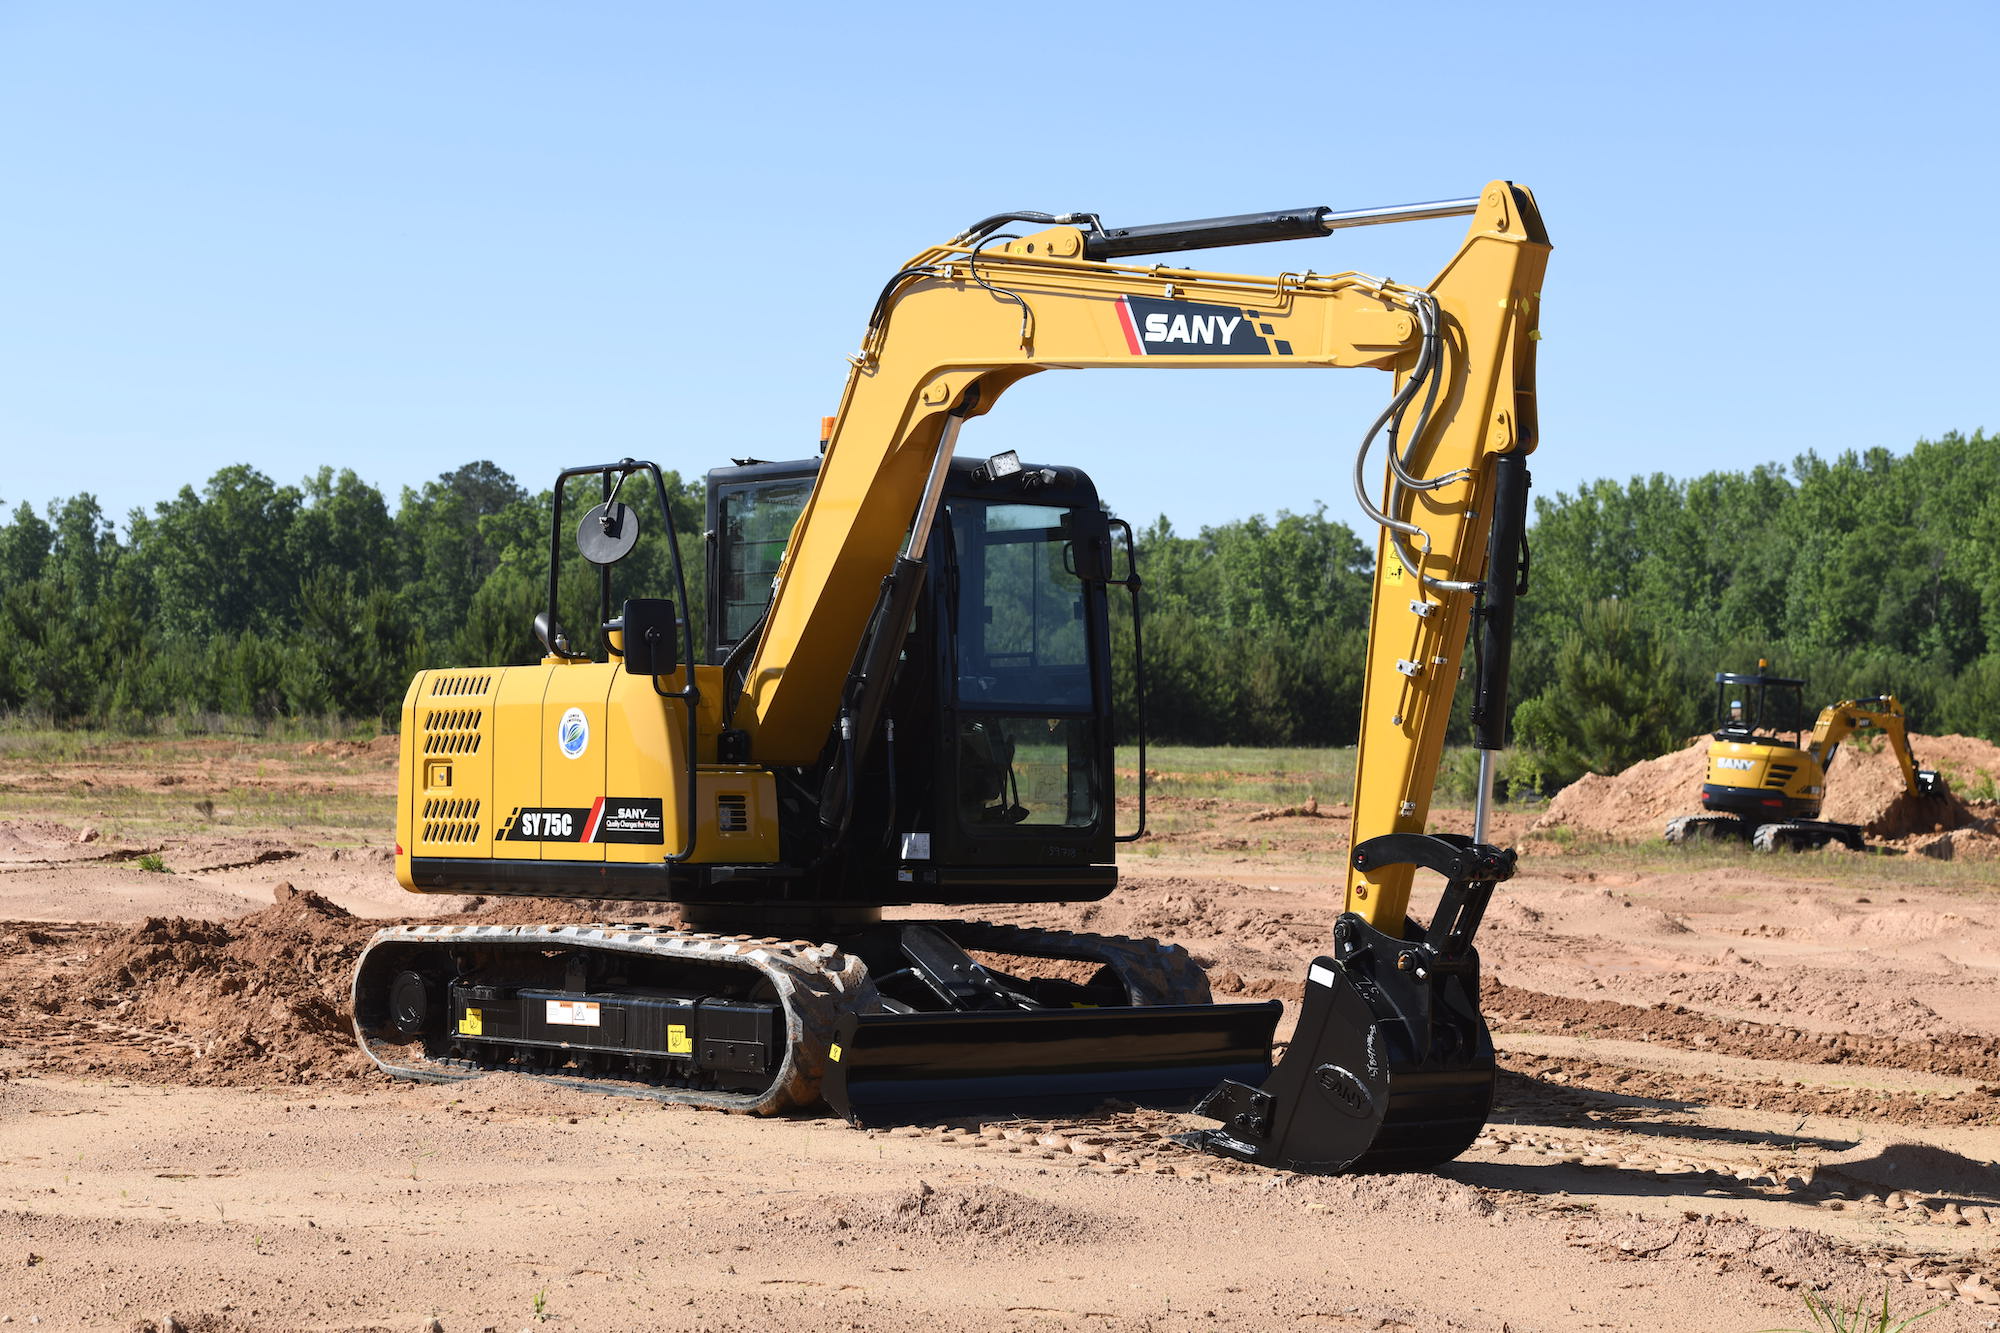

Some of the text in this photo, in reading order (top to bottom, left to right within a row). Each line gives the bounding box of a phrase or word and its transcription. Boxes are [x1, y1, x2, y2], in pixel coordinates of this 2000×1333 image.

[1144, 313, 1242, 345] SANY
[1717, 757, 1756, 771] SANY
[617, 808, 648, 819] SANY
[606, 819, 620, 828] Quality
[620, 820, 637, 829] Changes
[644, 820, 659, 828] World
[1319, 1071, 1366, 1111] SANY
